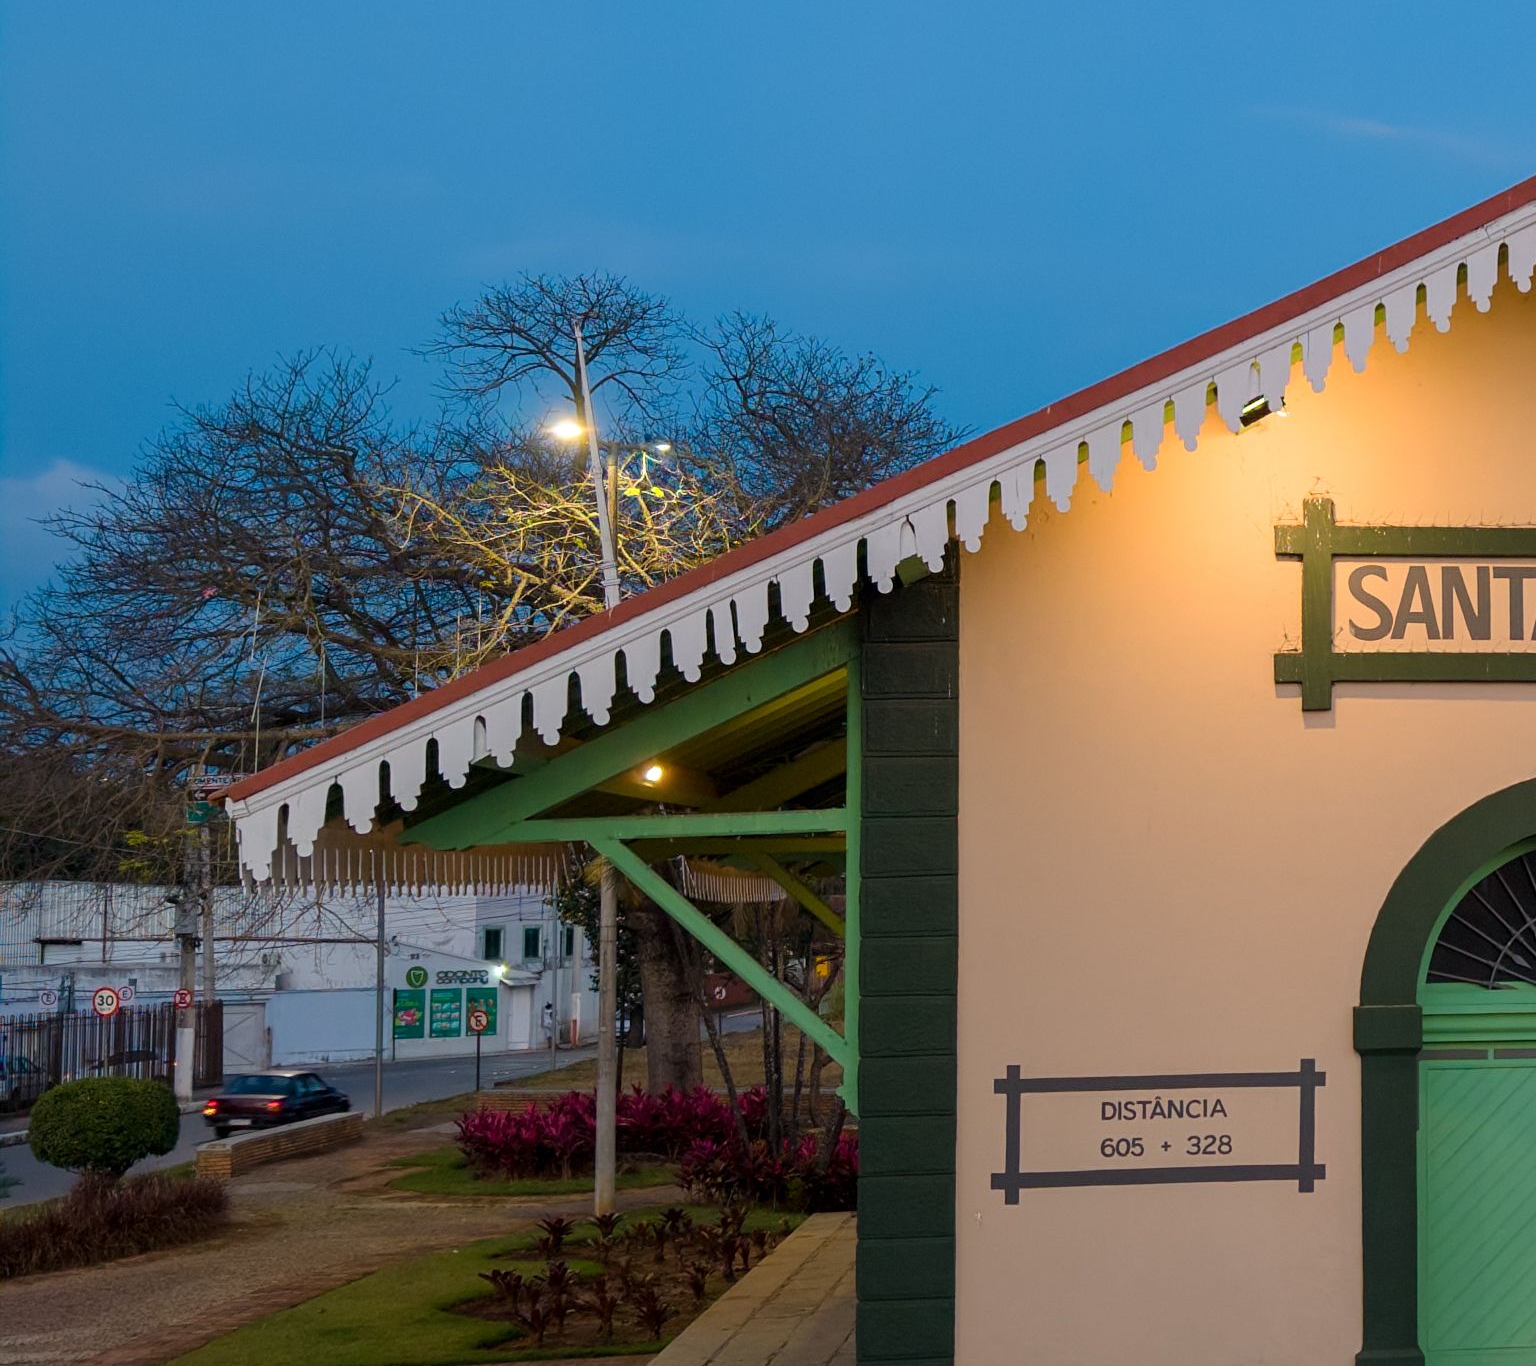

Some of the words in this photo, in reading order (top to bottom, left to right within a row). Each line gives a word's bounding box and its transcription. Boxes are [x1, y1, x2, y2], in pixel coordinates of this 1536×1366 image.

[97, 995, 114, 1006] 30
[1101, 1096, 1228, 1121] DISTÂNCIA
[1100, 1138, 1145, 1158] 605
[1160, 1141, 1172, 1152] +
[1185, 1135, 1233, 1156] 328
